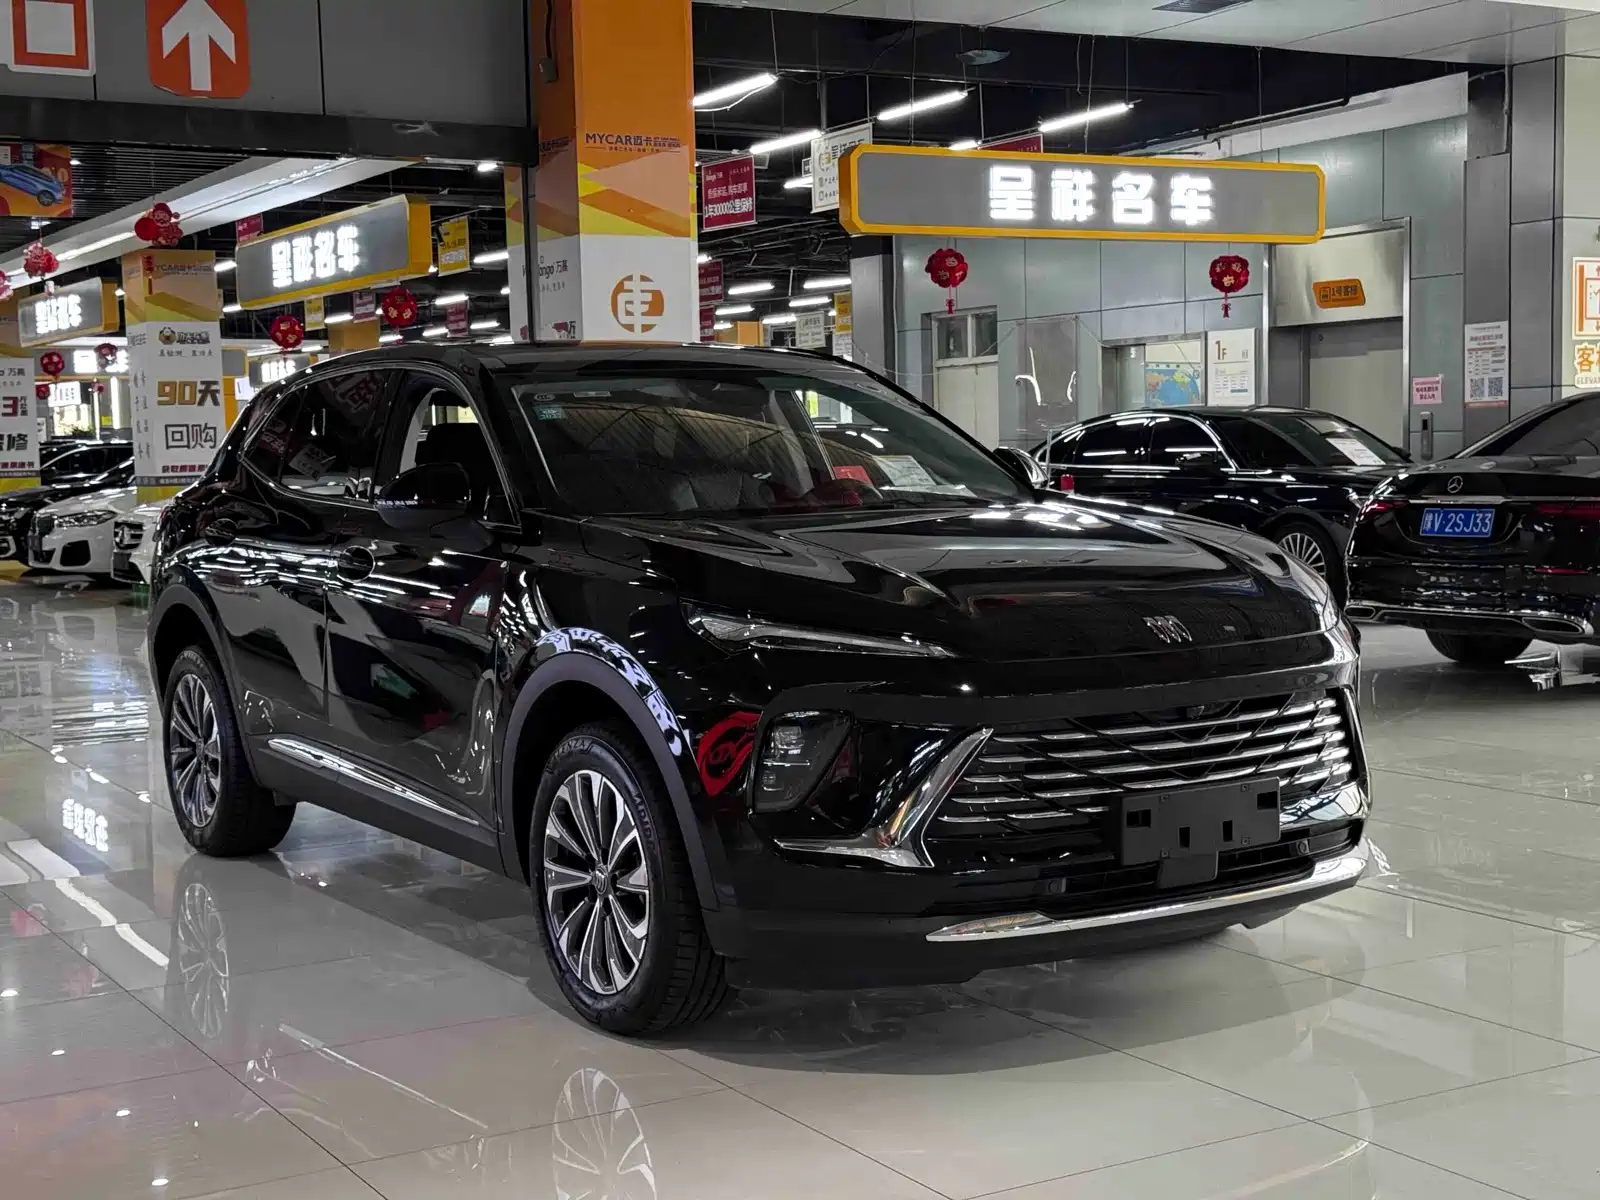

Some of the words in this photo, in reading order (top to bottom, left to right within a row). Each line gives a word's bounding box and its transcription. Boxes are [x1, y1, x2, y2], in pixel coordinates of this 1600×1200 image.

[988, 165, 1213, 226] 呈祥名车
[1577, 346, 1600, 373] 客
[157, 380, 220, 407] 90天
[165, 422, 217, 450] 回购
